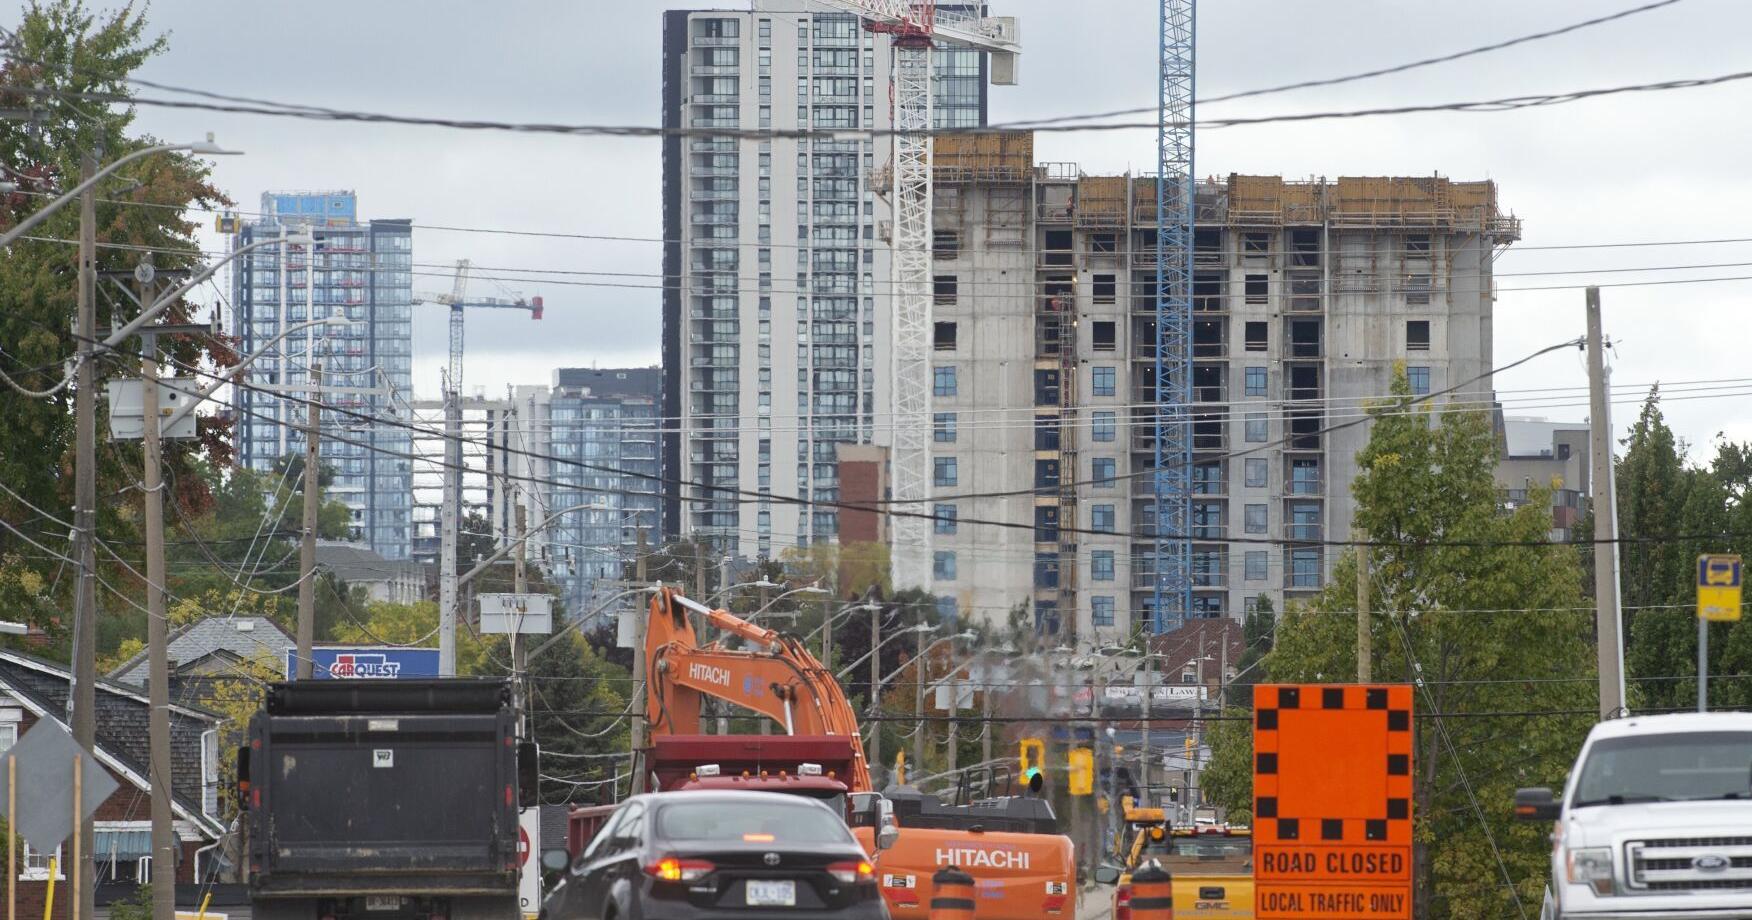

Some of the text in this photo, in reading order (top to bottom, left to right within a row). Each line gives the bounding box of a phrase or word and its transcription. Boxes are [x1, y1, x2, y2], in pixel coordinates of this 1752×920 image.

[688, 662, 731, 687] HITACHI
[935, 848, 1030, 870] HITACHI
[1263, 852, 1403, 874] ROAD CLOSED
[1194, 901, 1232, 910] GMC
[1260, 892, 1405, 913] LOCAL TRAFFIC ONLY
